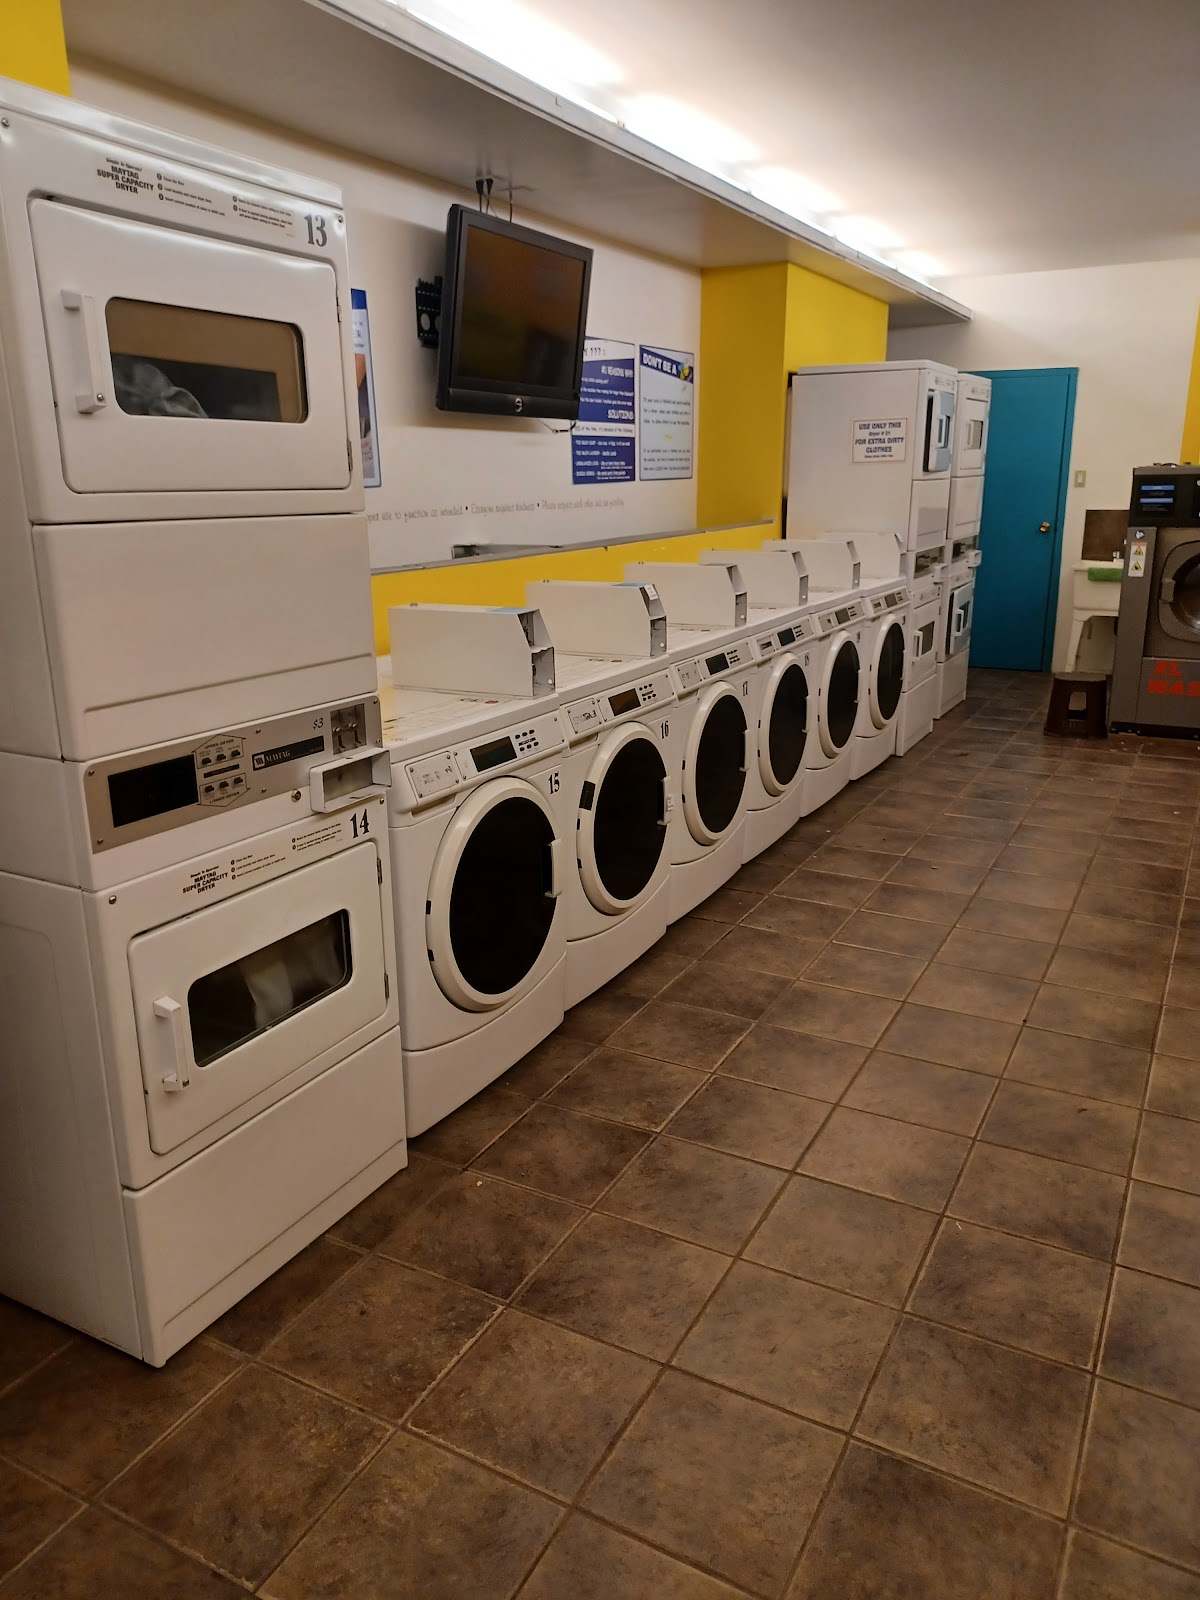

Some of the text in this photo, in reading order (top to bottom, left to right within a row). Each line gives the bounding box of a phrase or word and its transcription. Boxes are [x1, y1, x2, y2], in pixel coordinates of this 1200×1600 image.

[97, 169, 120, 182] SUPER
[121, 175, 154, 191] CAPACITY
[111, 165, 139, 180] MAYTAG
[115, 182, 138, 194] DRYER
[304, 213, 327, 247] 13
[643, 352, 677, 375] DON'T BE A
[871, 422, 887, 430] ONLY
[888, 421, 901, 429] THIS
[887, 436, 904, 444] DIRTY
[1152, 660, 1183, 676] XL
[313, 717, 324, 730] $3
[660, 720, 669, 739] 16
[548, 772, 560, 794] 15
[350, 808, 369, 839] 14
[182, 872, 228, 894] SUPER CAPACITY
[194, 871, 216, 883] MAYTAG
[198, 883, 216, 894] DRYER
